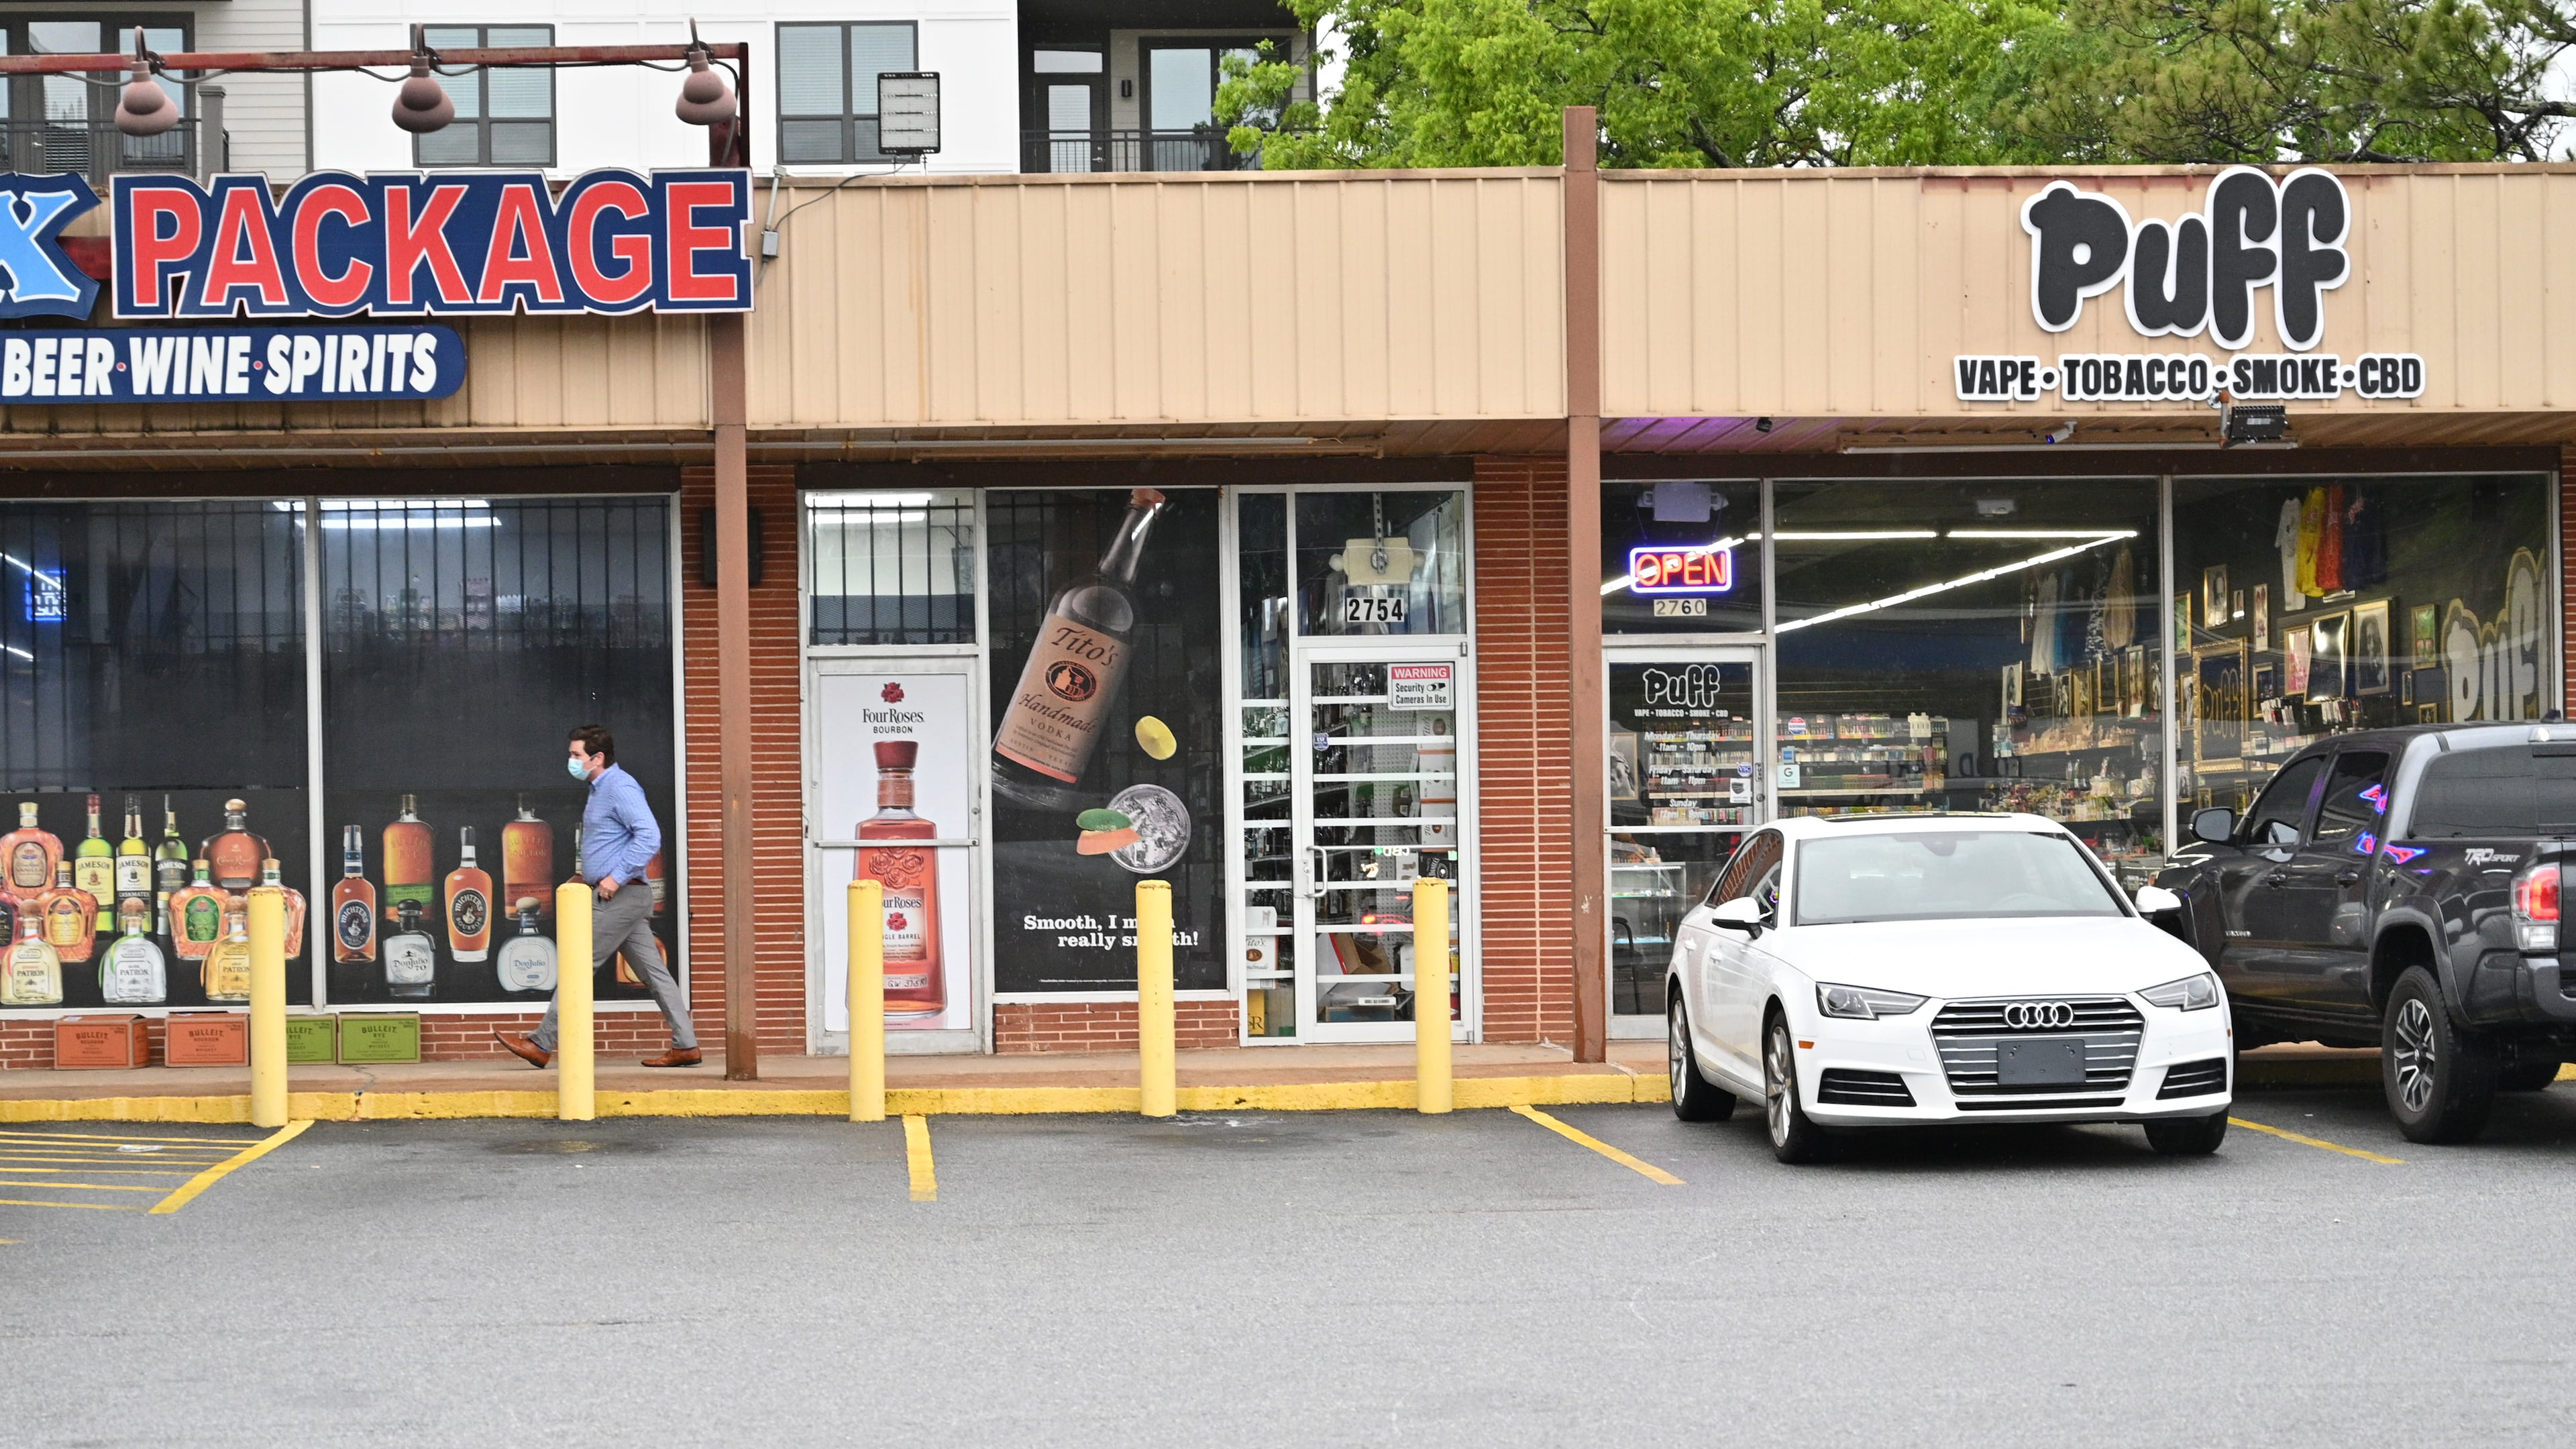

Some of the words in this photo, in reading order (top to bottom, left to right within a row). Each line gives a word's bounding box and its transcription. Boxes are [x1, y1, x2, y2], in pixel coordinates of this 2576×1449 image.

[130, 180, 739, 307] PACKAGE
[2027, 169, 2348, 344] Puff
[3, 337, 114, 397] BEER
[128, 335, 251, 396] WINE
[262, 331, 438, 394] SPIRITS
[1959, 360, 2036, 394] VAPE
[2063, 358, 2208, 395] TOBACCO
[2233, 358, 2339, 394] SMOKE
[2359, 358, 2421, 393] CBD
[1635, 553, 1727, 586] OPEN
[1348, 598, 1403, 621] 2754
[1655, 599, 1705, 615] 2760
[1051, 627, 1119, 668] Tito's
[1394, 667, 1447, 679] WARNING
[1395, 683, 1425, 694] Security
[1643, 664, 1720, 708] Puff
[1395, 694, 1425, 704] Cameras
[1426, 694, 1433, 704] In
[1434, 694, 1447, 704] Use
[862, 708, 889, 723] Four
[1018, 693, 1096, 734] Handmade
[1634, 708, 1650, 717] VAPE
[1655, 709, 1684, 718] TOBACCO
[1689, 709, 1711, 718] SMOKE
[1715, 709, 1729, 718] CBD
[873, 725, 913, 734] BOURBON
[1030, 717, 1071, 742] VODKA
[1644, 731, 1676, 741] Monday
[1686, 731, 1721, 741] Thursday
[1659, 743, 1677, 751] 11am
[1686, 742, 1707, 752] 10pm
[1649, 765, 1673, 775] Friday
[1682, 765, 1716, 774] Saturday
[1660, 776, 1678, 785] 11am
[1688, 775, 1706, 786] 11pm
[1669, 798, 1698, 808] Sunday
[2464, 847, 2494, 866] TRD
[2490, 854, 2521, 863] SPORT
[77, 860, 111, 871] JAMESON
[117, 859, 149, 870] JAMESON
[157, 861, 187, 871] JAMESON
[882, 899, 894, 908] ur
[894, 896, 922, 909] Roses
[455, 916, 483, 932] BOURBON
[1024, 914, 1102, 931] Smooth,
[1108, 914, 1117, 929] I
[1058, 932, 1116, 951] really
[1122, 930, 1199, 947] sth!
[76, 1031, 109, 1040] BULLEIT
[189, 1030, 224, 1038] BULLEIT
[286, 1026, 313, 1035] LLEIT
[362, 1025, 397, 1034] BULLEIT
